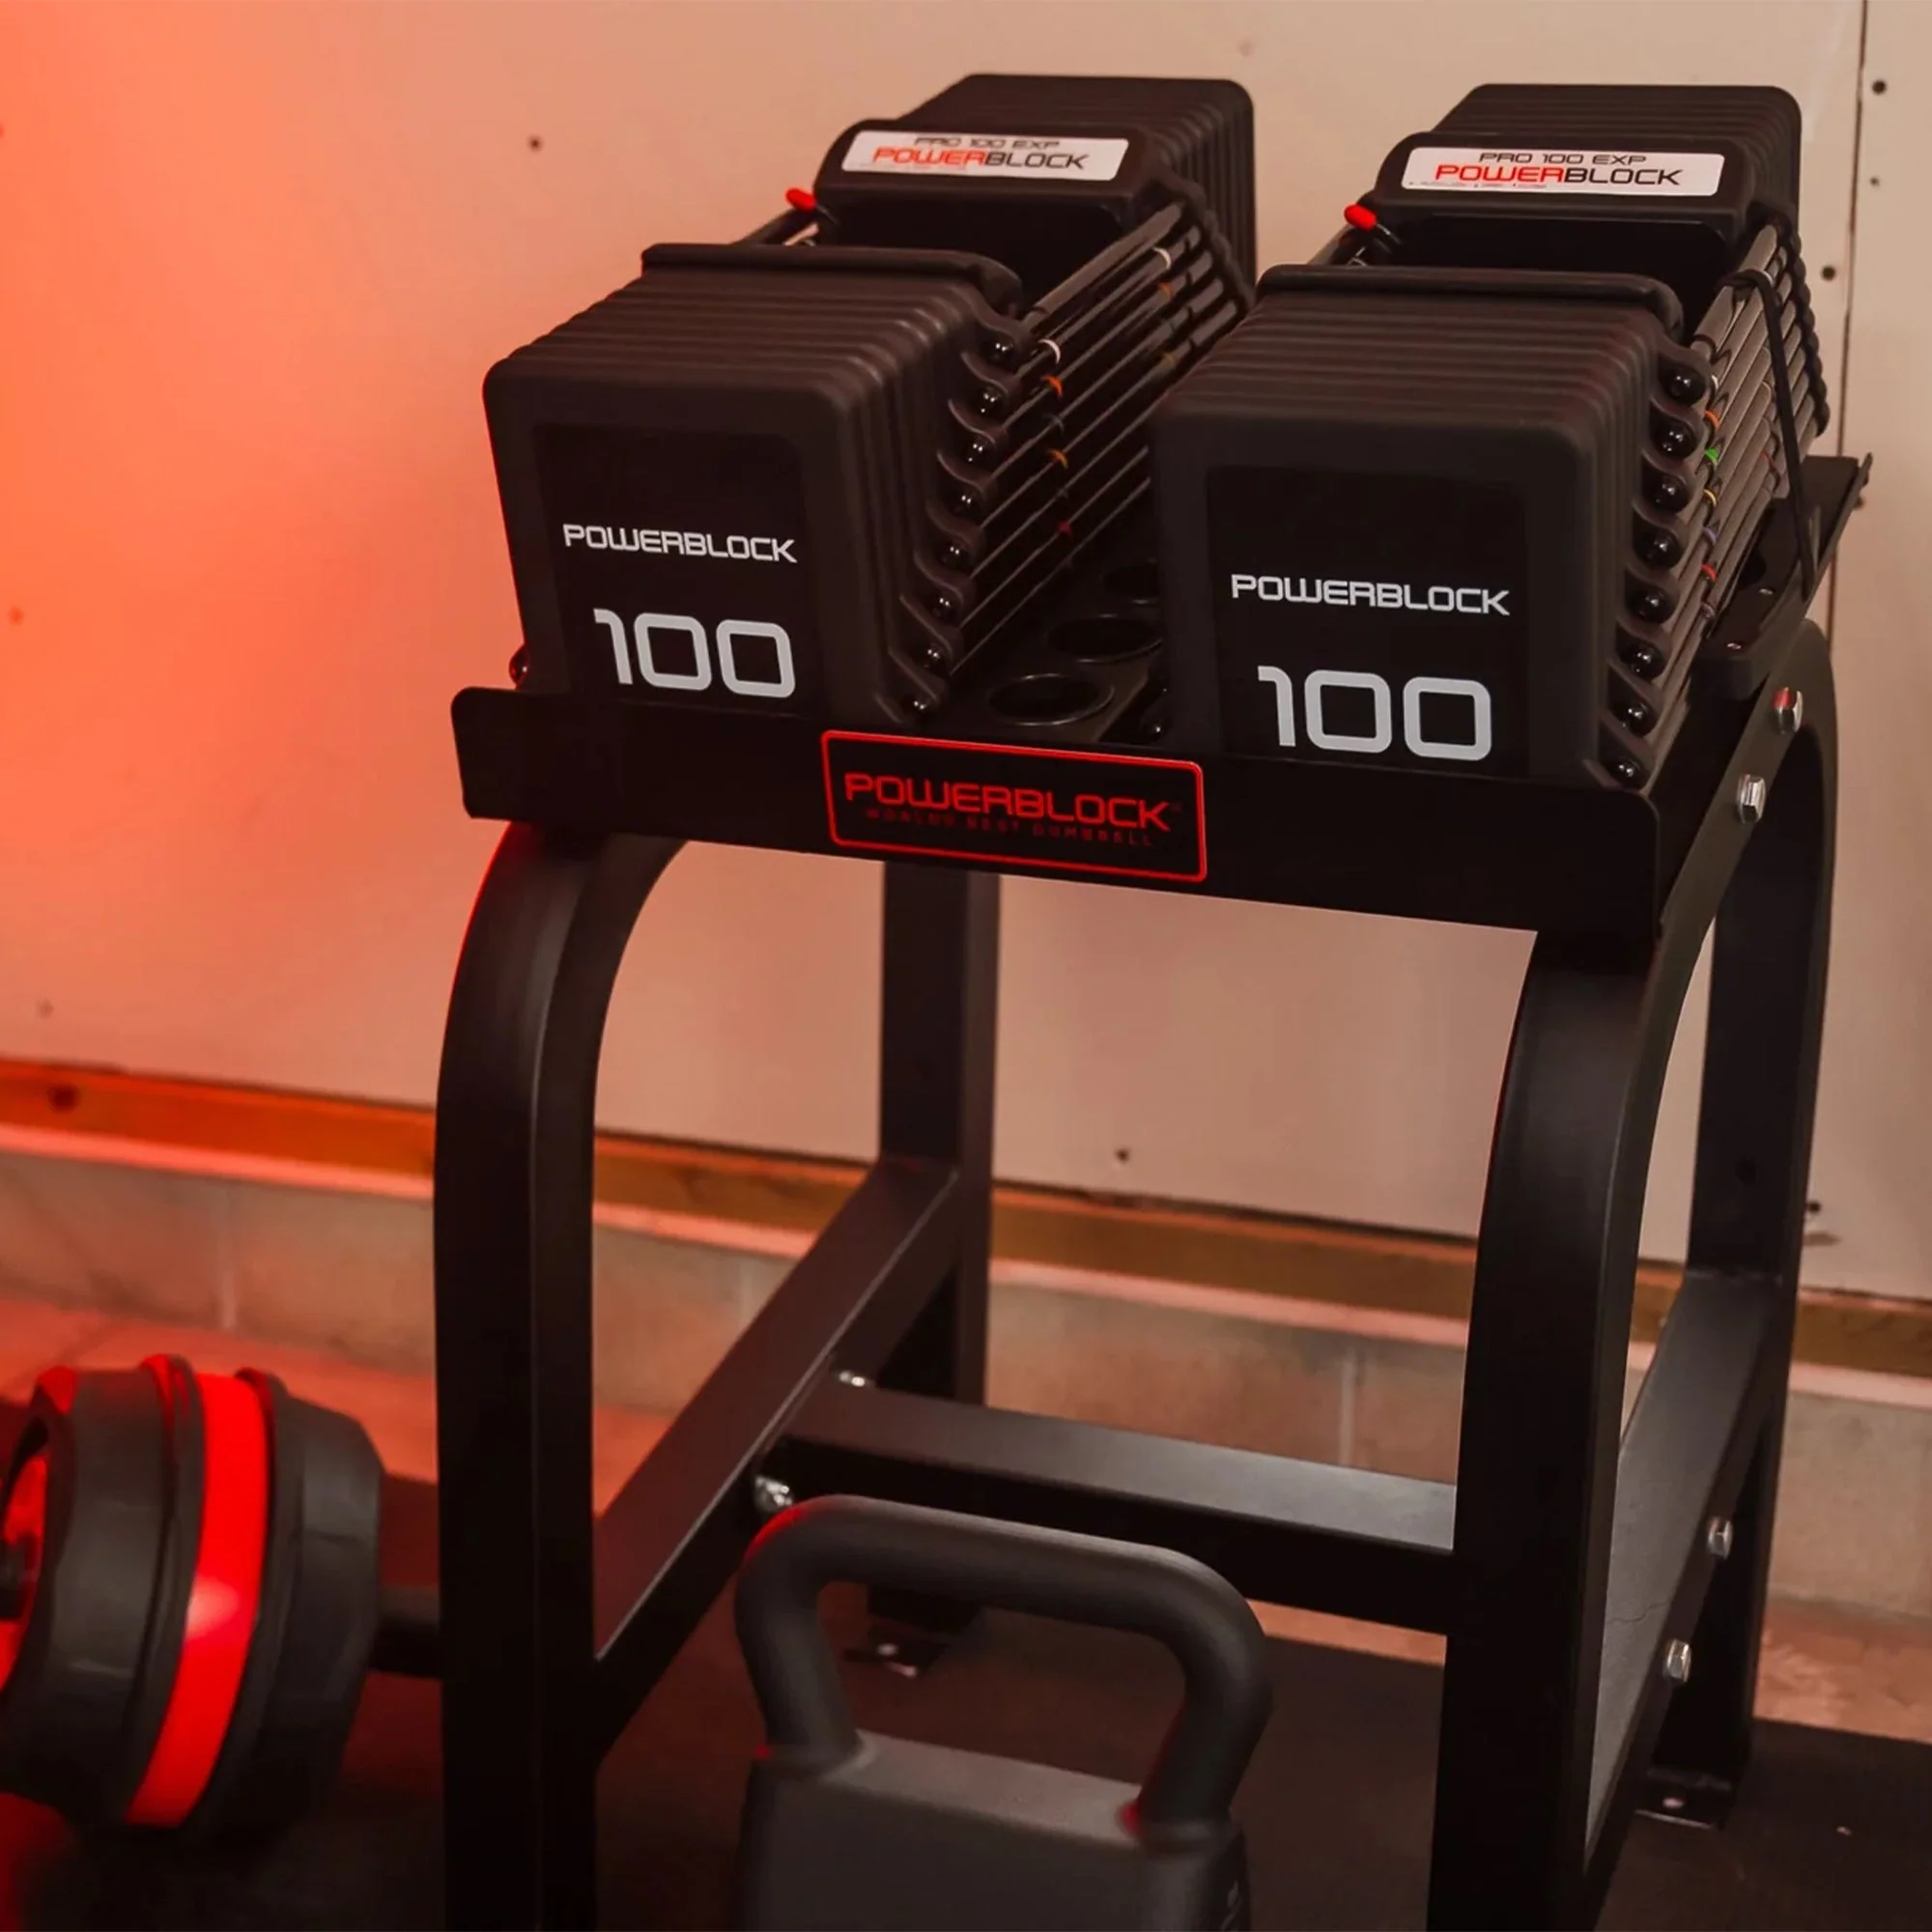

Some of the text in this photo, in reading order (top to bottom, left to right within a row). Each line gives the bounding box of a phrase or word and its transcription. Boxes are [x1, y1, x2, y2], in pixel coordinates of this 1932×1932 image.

[872, 148, 1089, 169] POWERBLOCK
[1435, 164, 1683, 185] POWERBLOCK
[1479, 153, 1646, 165] PRO 100 EXP
[563, 524, 797, 563] POWERBLOCK
[1232, 574, 1510, 616] POWERBLOCK
[593, 608, 796, 698] 100
[1258, 666, 1492, 761] 100
[844, 773, 1171, 832] POWERBLOCK
